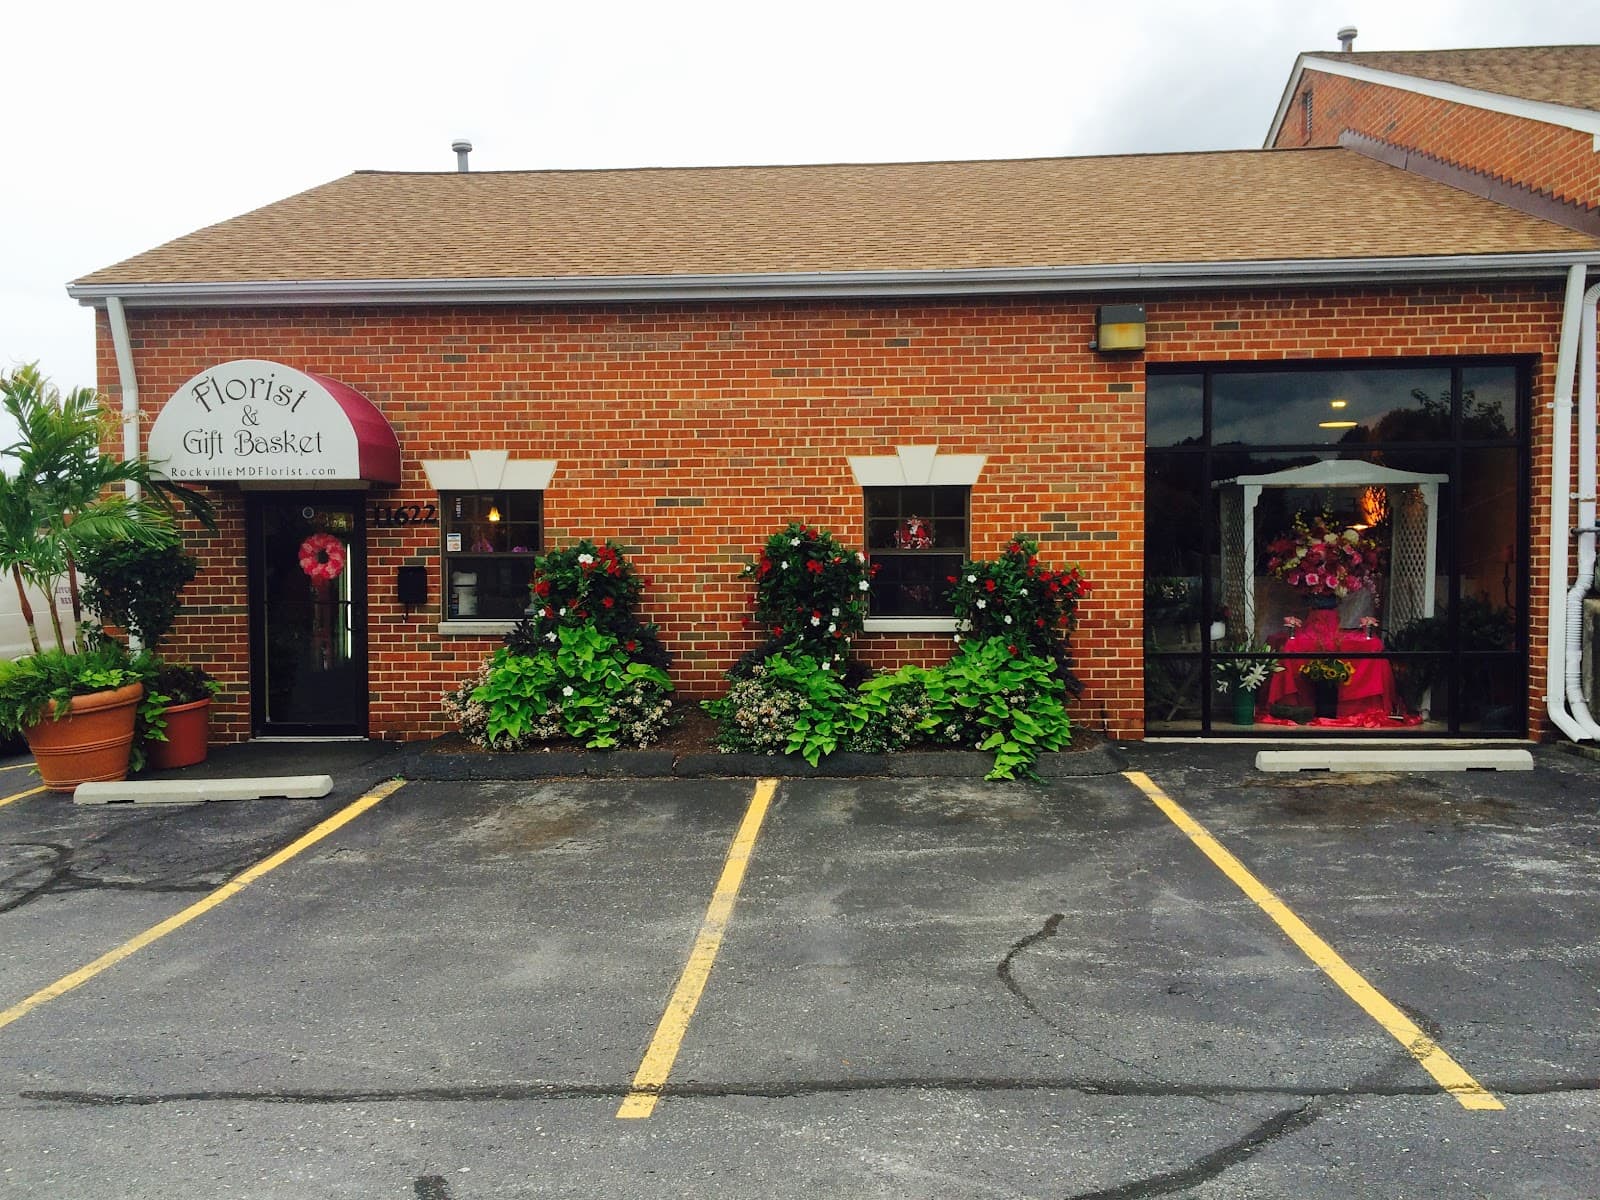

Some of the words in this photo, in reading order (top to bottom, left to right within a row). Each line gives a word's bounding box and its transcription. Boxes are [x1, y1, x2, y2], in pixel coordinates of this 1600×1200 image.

[191, 373, 309, 413] Florist
[242, 405, 260, 426] &
[183, 429, 223, 460] Gift
[234, 430, 322, 456] Basket
[171, 467, 336, 477] RockvilleMDFlorist.com
[374, 504, 438, 525] 11622
